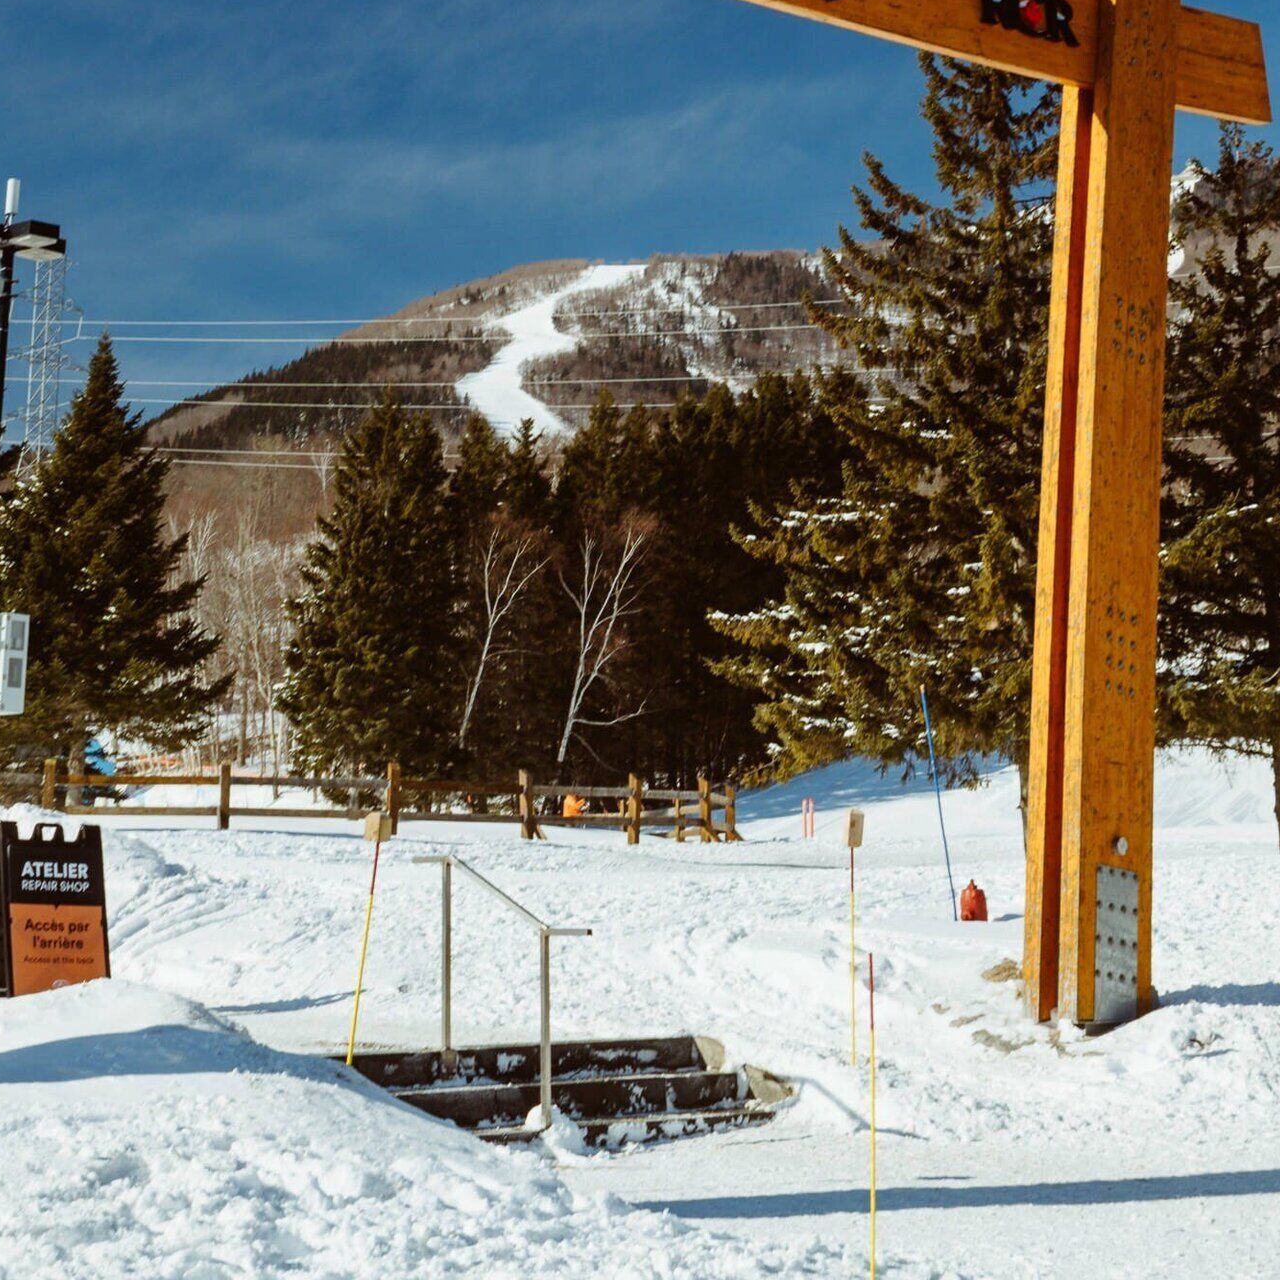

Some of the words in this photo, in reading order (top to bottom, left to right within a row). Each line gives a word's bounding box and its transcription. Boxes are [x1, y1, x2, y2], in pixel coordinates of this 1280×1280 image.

[21, 861, 89, 879] ATELIER
[21, 880, 58, 891] REPAIR
[60, 880, 90, 892] SHOP
[24, 919, 65, 931] Accès
[68, 922, 90, 934] par
[33, 935, 83, 949] l'arrière
